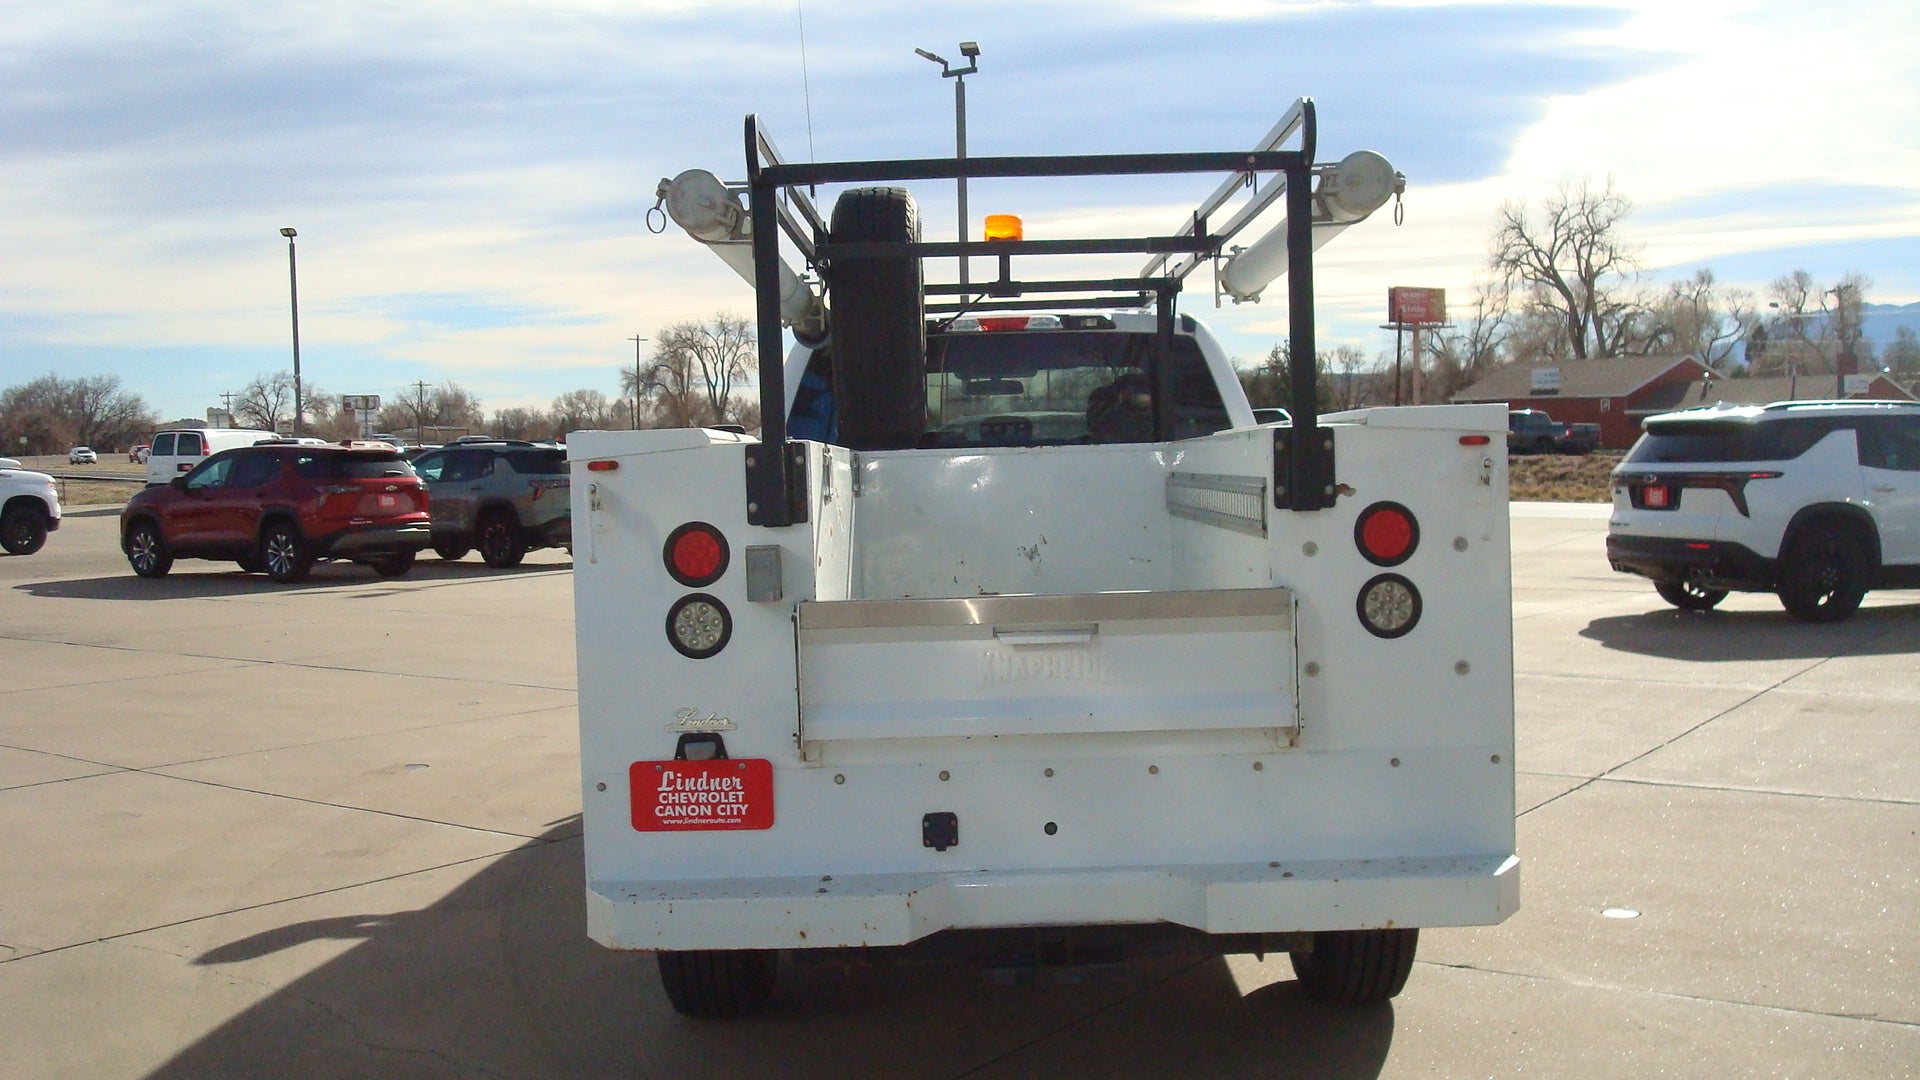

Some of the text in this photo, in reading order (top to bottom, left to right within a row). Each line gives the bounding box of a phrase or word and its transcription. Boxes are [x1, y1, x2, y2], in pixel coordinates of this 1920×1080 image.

[657, 771, 743, 791] Lindner
[658, 792, 745, 803] CHEVROLET
[655, 804, 749, 817] CANON CITY
